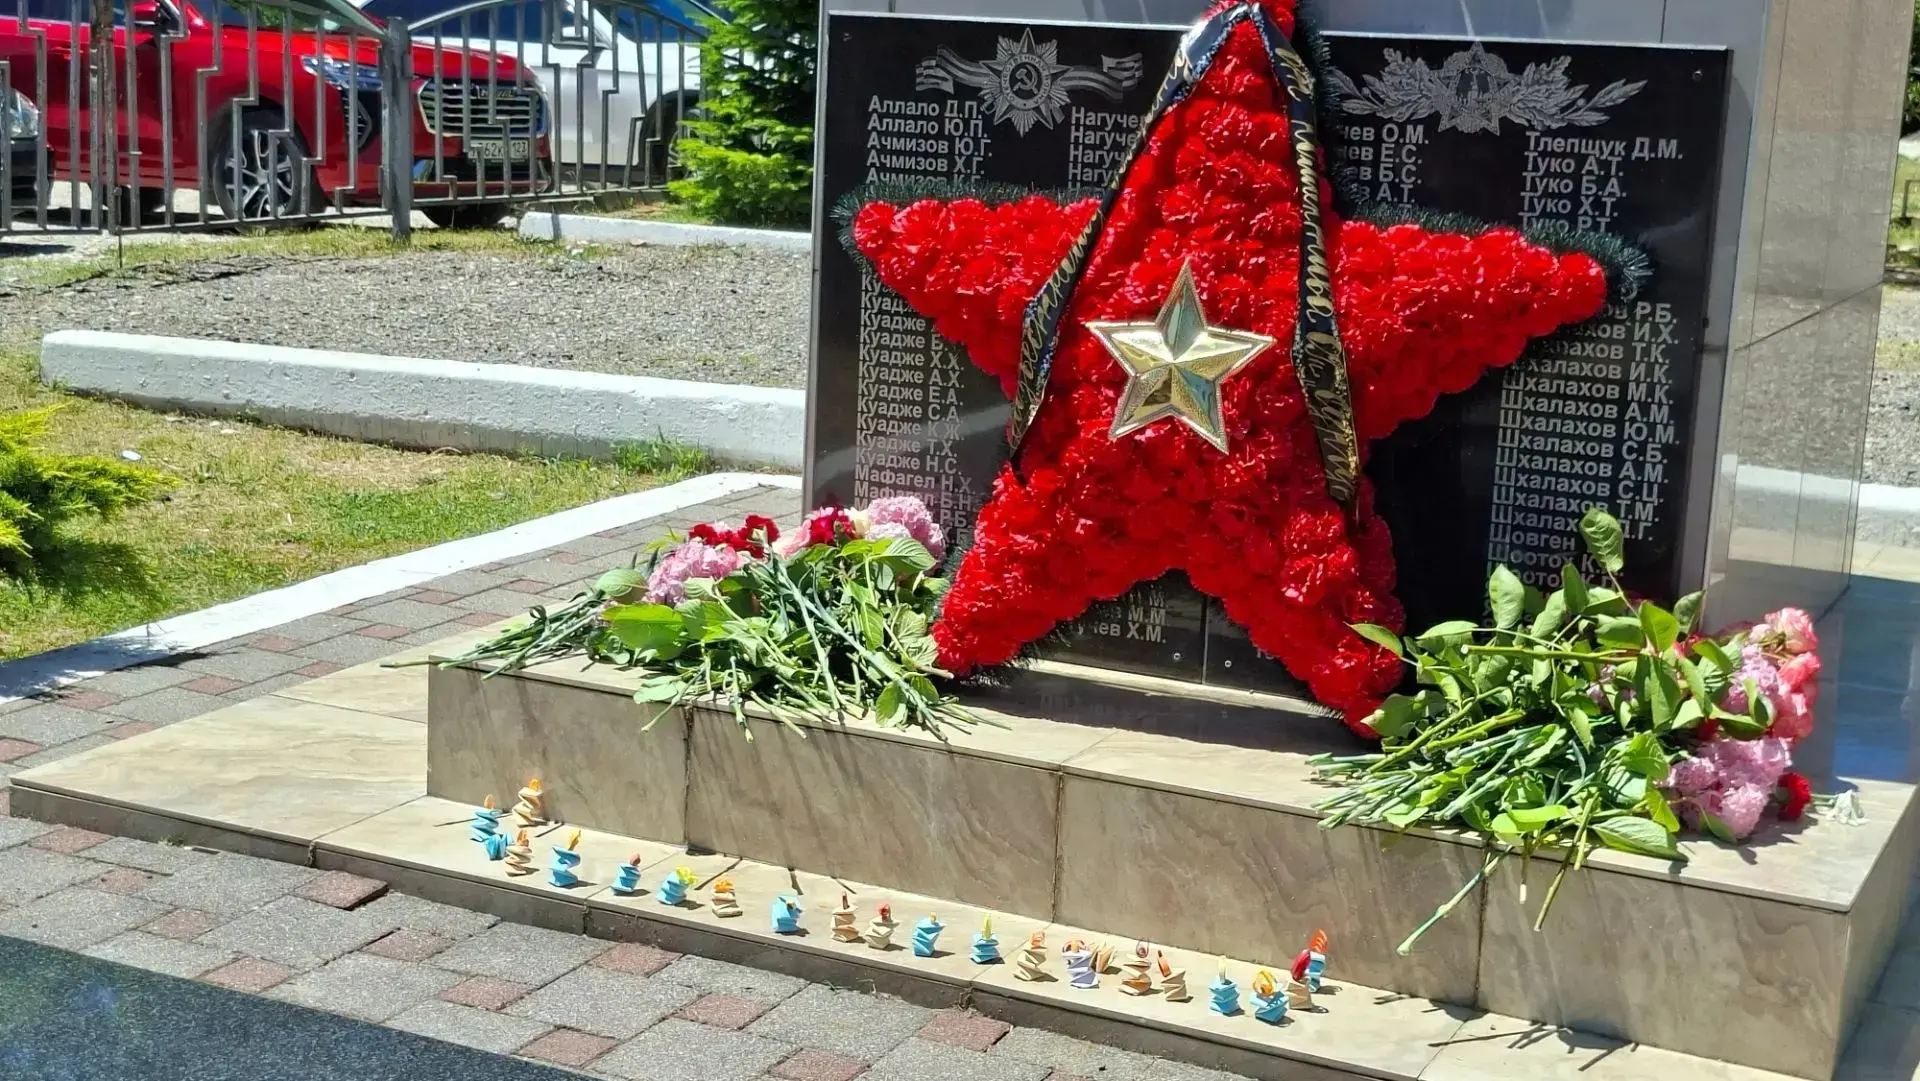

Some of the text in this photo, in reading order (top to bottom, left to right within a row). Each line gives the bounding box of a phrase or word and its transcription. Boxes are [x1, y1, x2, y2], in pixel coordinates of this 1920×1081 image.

[868, 95, 982, 119] Аллало Д.П.
[867, 113, 988, 138] Аллало Ю.П.
[1381, 122, 1429, 145] О.М.
[867, 131, 992, 157] Ачмизов Ю.Г.
[1380, 143, 1422, 164] Е.С.
[1525, 131, 1683, 162] Тлепщук Д.М.
[866, 149, 985, 175] Ачмизов Х.Г.
[1068, 162, 1116, 187] Нагу
[1379, 163, 1422, 184] Б.С.
[1524, 151, 1624, 177] Туко А.Т.
[1376, 182, 1415, 203] А.Т.
[1522, 172, 1627, 197] Туко Б.А.
[1520, 192, 1619, 217] Туко Х.Т.
[861, 291, 912, 314] Куад
[1635, 301, 1677, 324] Р.Б.
[860, 308, 926, 332] Куадже
[860, 326, 926, 349] Куадже
[1633, 322, 1679, 345] И.Х.
[860, 343, 965, 371] Куадже Х.Х.
[1631, 342, 1670, 364] Т.К.
[859, 361, 965, 389] Куадже А.Х.
[1526, 357, 1673, 385] халахов И.К.
[859, 378, 964, 406] Куадже Е.А.
[1502, 372, 1674, 405] Шхалахов М.К.
[858, 395, 964, 423] Куадже С.А.
[1500, 389, 1675, 425] Шхалахов А.М.
[857, 412, 922, 435] Куадже
[1499, 409, 1680, 445] Шхалахов Ю.М.
[856, 430, 958, 458] Куадже Т.Х.
[1498, 428, 1669, 464] Шхалахов С.Б.
[856, 447, 962, 475] Куадже Н.С.
[1496, 447, 1670, 484] Шхалахов А.М.
[855, 464, 976, 495] Мафагел Н.Х.
[1494, 466, 1665, 507] Шхалахов С.Ц.
[1491, 504, 1580, 533] Шхалах
[1616, 499, 1660, 522] Т.М.
[1126, 621, 1167, 644] Х.М.
